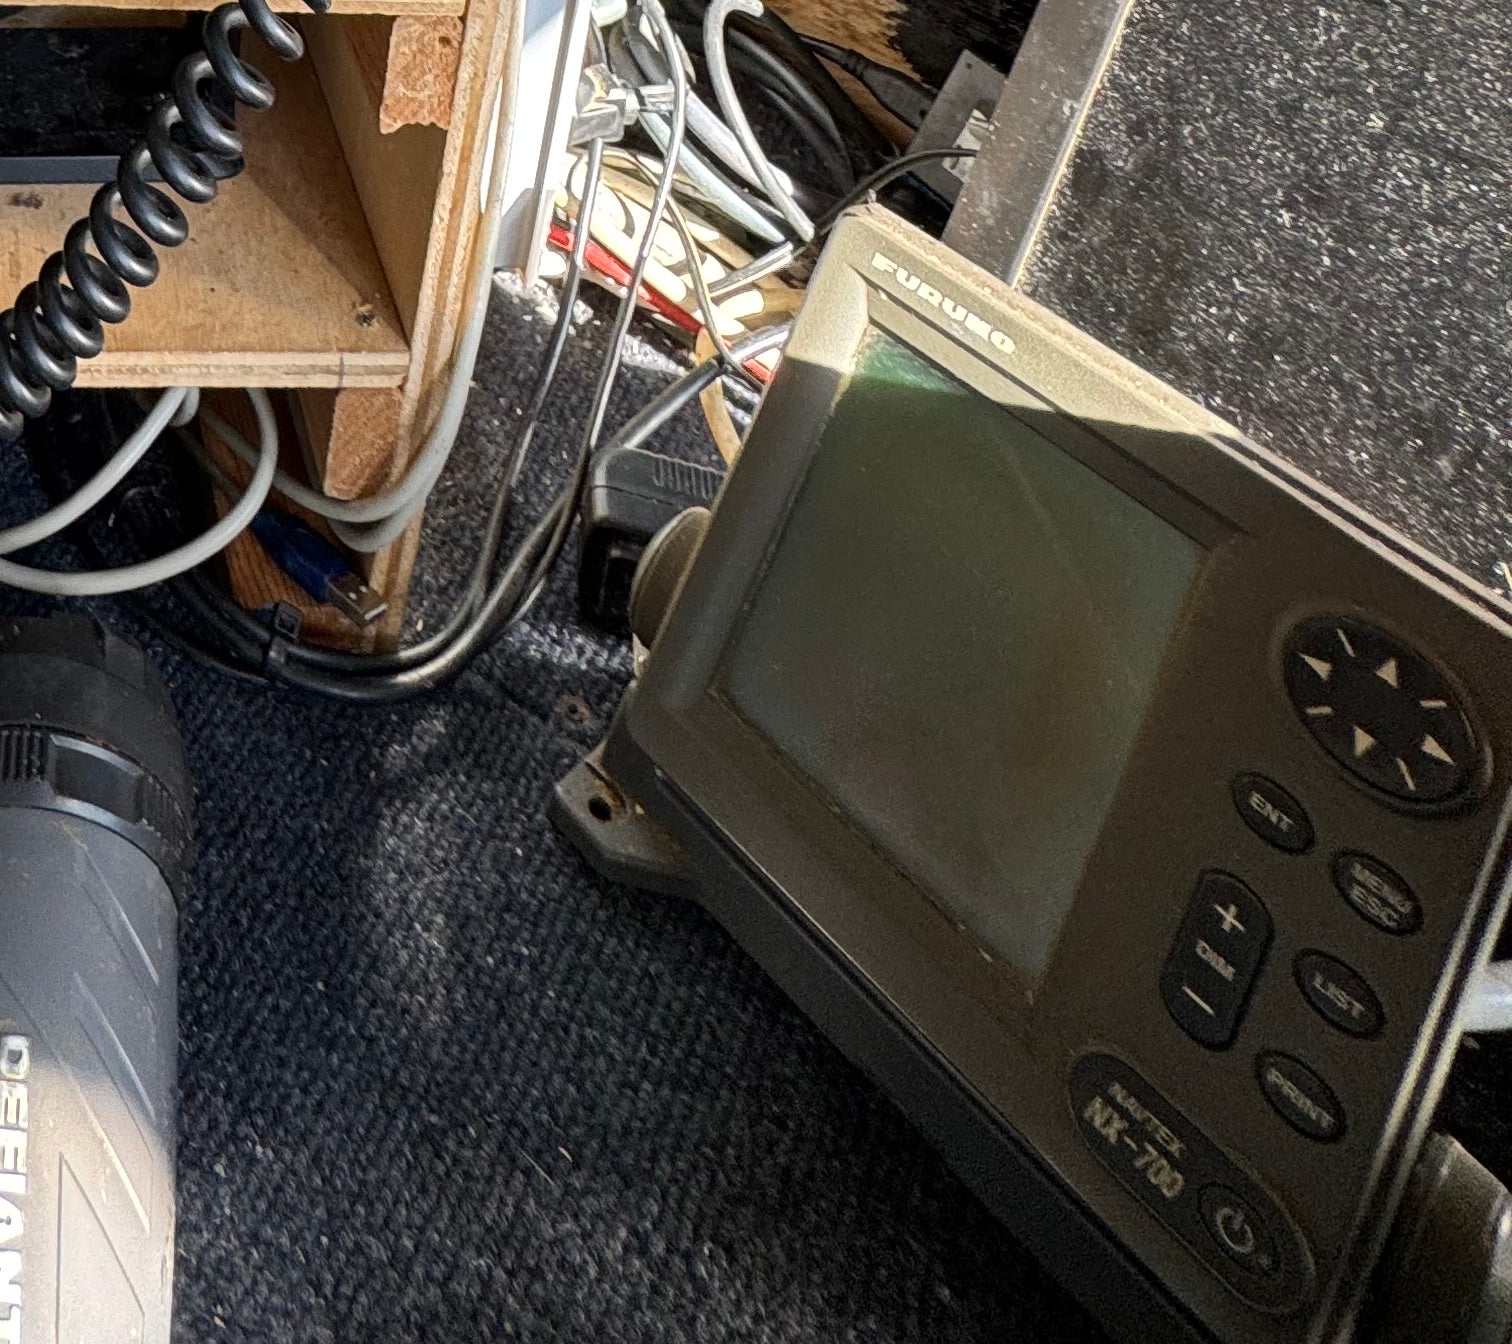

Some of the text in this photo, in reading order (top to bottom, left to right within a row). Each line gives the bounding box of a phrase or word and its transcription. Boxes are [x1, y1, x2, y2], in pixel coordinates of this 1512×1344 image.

[871, 251, 1016, 354] FURUNO
[1249, 792, 1294, 832] ENT
[1349, 885, 1399, 927] ESC
[1195, 941, 1237, 978] DIM
[1312, 975, 1364, 1017] LIST
[1108, 1082, 1184, 1156] NAVTEX
[1265, 1070, 1336, 1129] PRINT
[1084, 1097, 1184, 1199] NX-700
